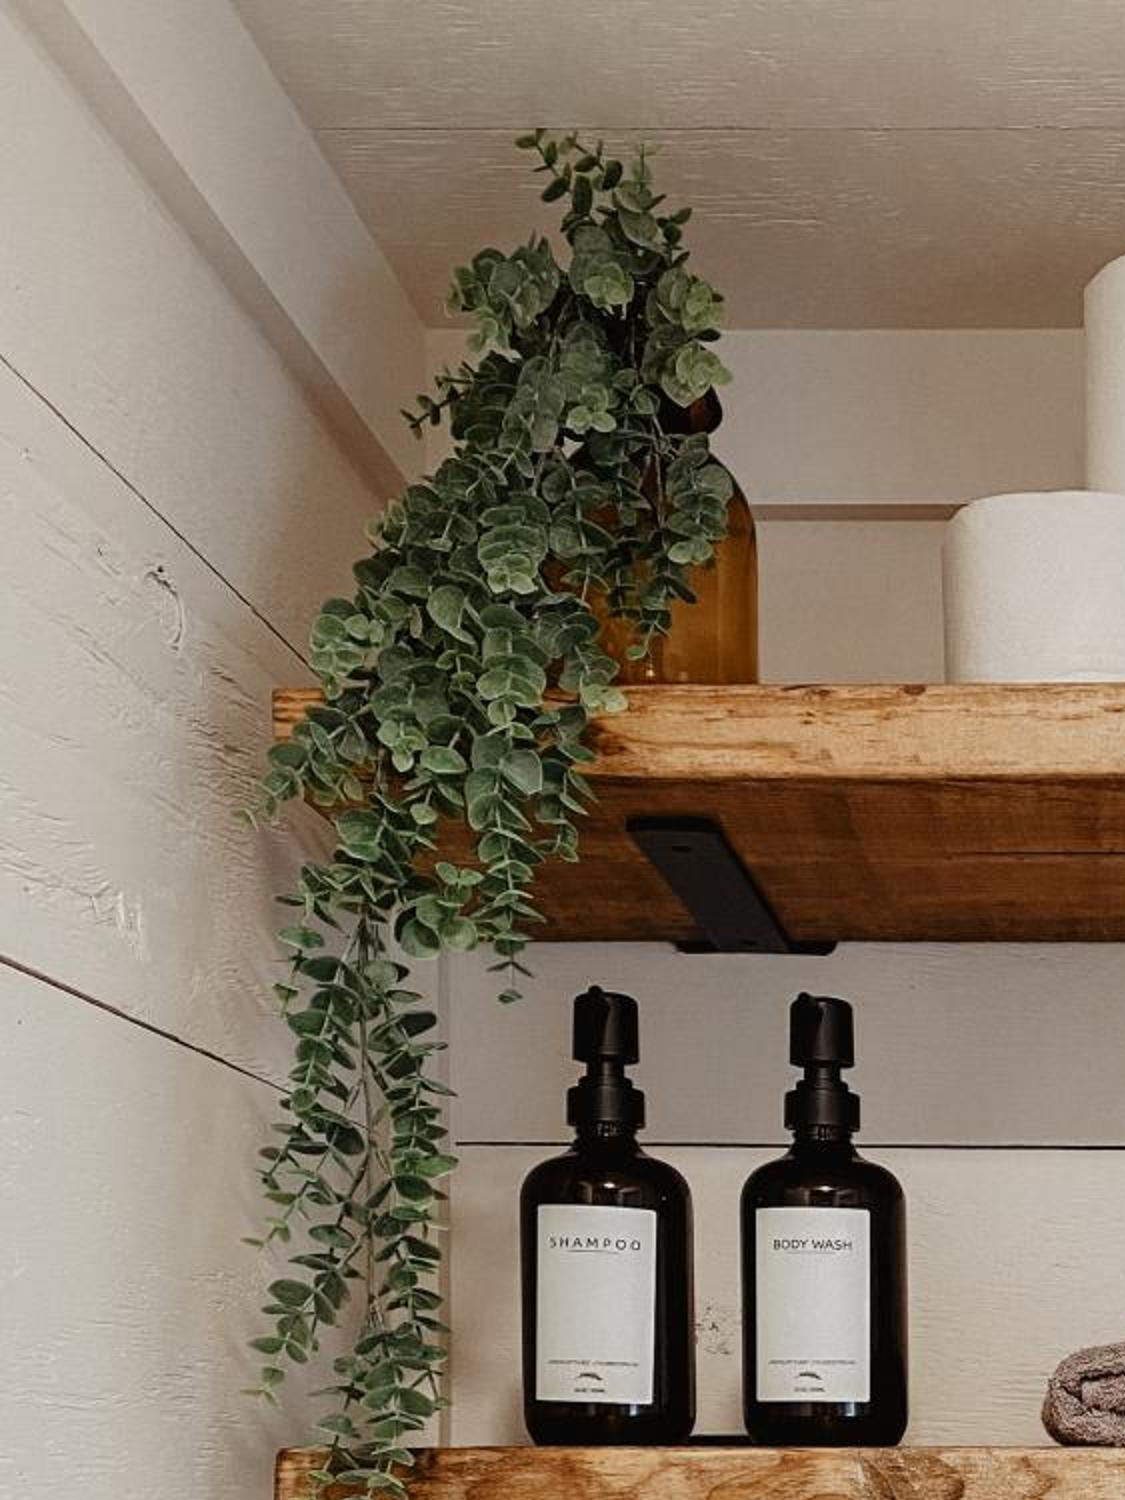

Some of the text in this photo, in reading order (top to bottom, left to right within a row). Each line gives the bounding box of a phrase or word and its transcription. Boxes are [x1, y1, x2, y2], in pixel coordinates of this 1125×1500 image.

[549, 1237, 641, 1251] SHAMPOO
[773, 1239, 853, 1250] BODY WASH
